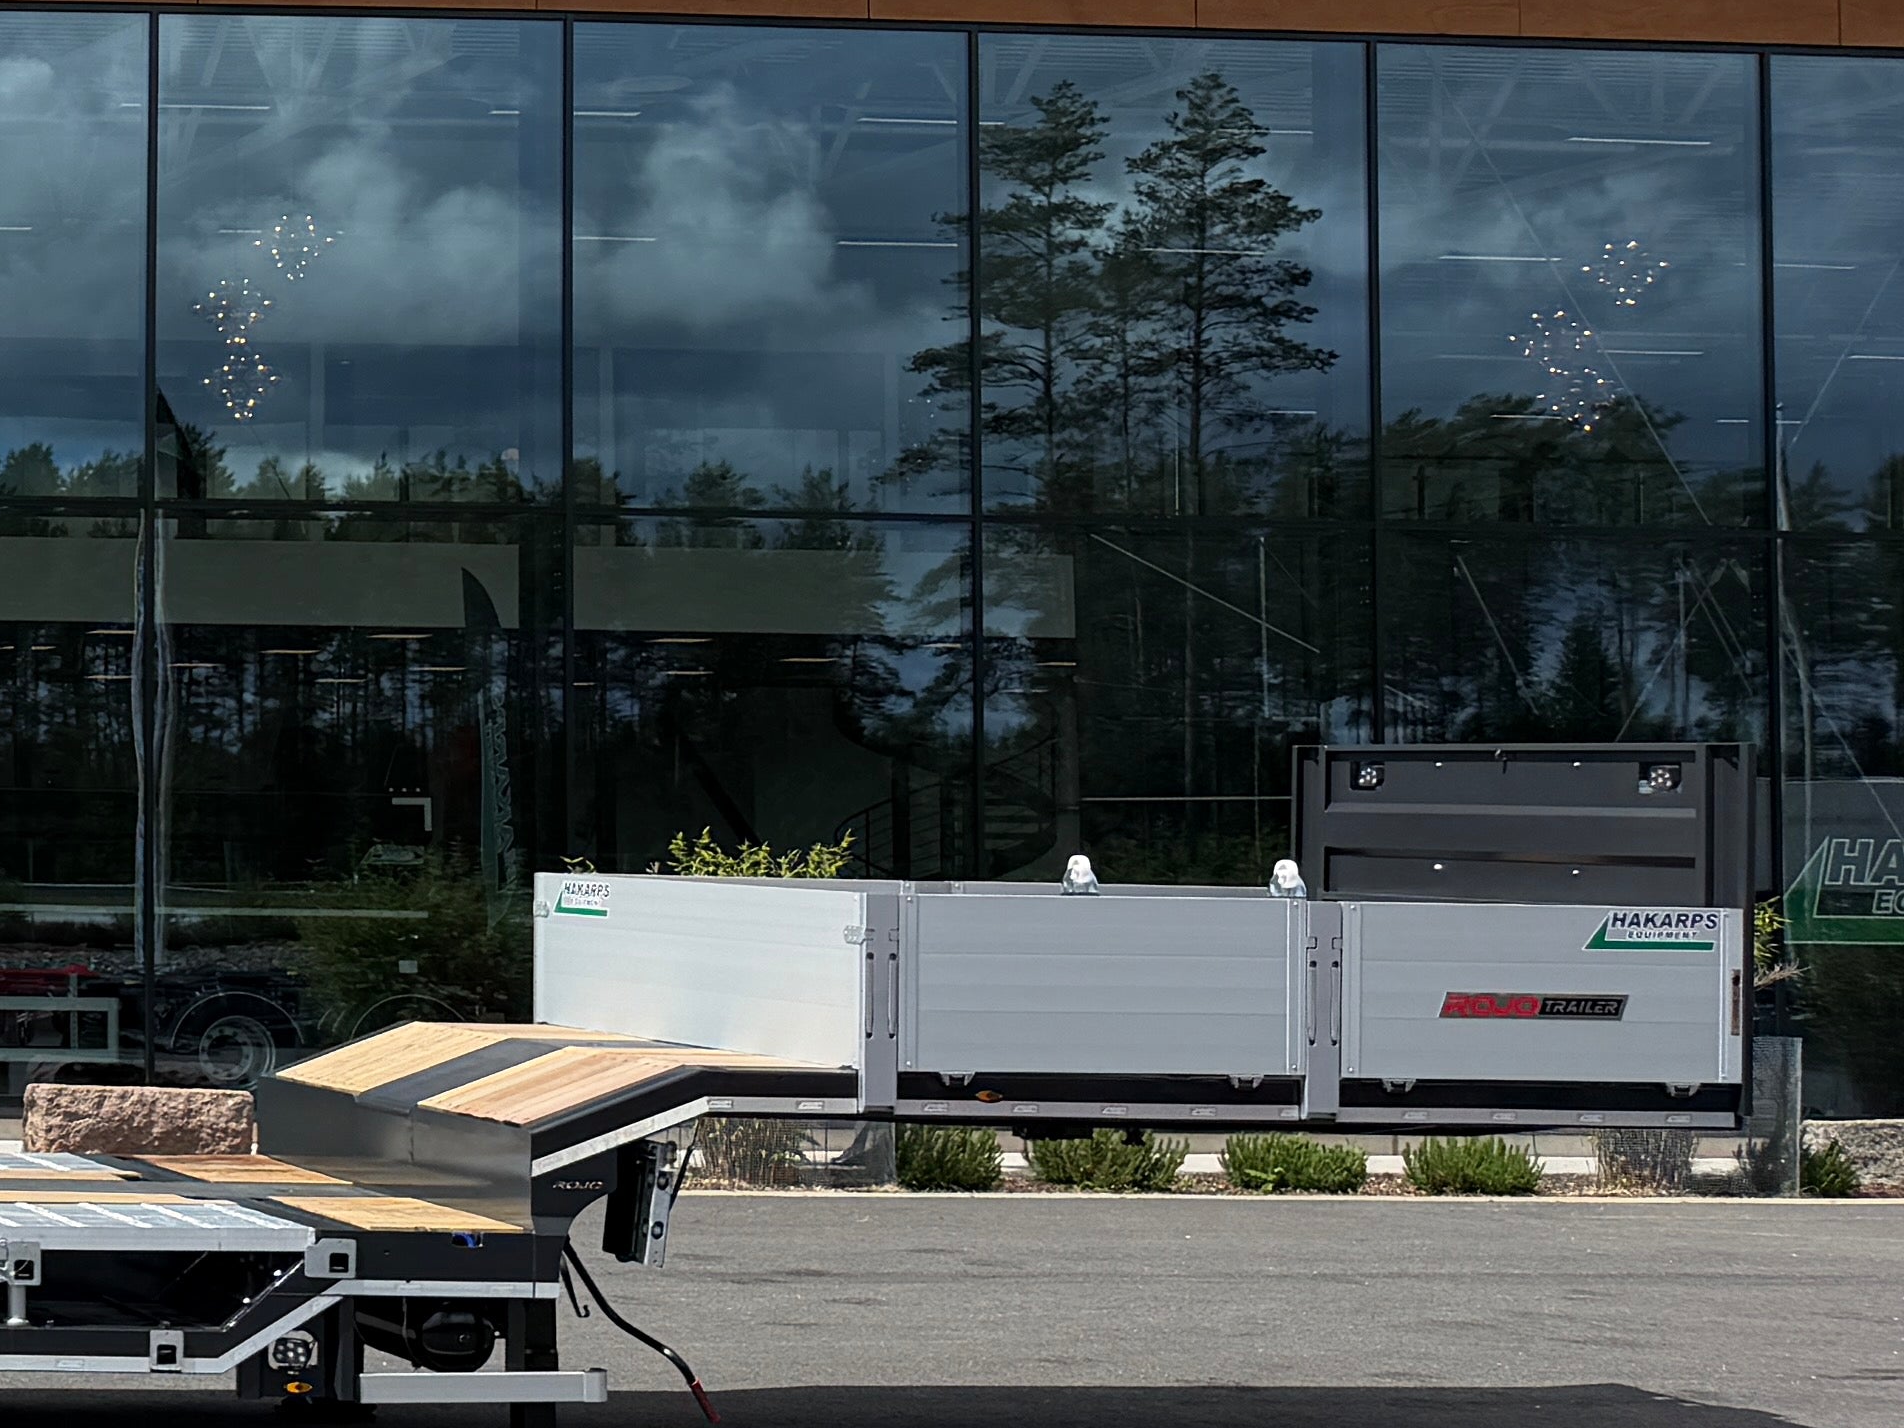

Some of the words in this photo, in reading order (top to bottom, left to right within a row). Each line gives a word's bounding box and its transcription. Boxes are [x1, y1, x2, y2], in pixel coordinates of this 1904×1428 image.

[1611, 912, 1719, 929] HAKARPS
[1627, 931, 1697, 940] EQUIPMENT
[1445, 994, 1542, 1018] ROJO
[1544, 999, 1618, 1015] TRAILER
